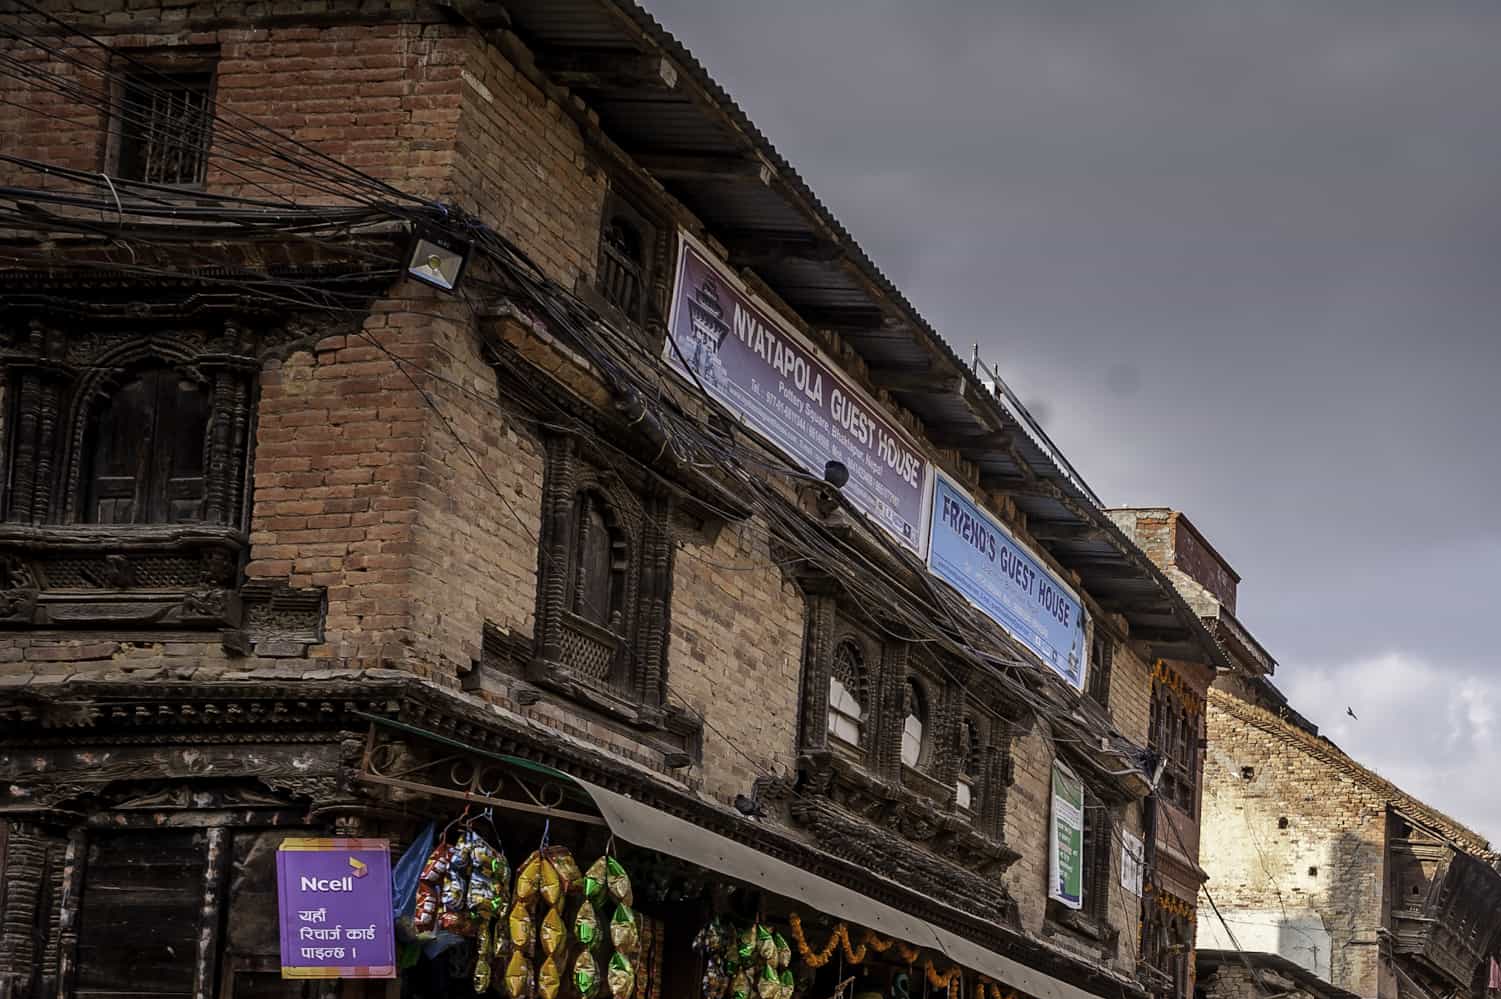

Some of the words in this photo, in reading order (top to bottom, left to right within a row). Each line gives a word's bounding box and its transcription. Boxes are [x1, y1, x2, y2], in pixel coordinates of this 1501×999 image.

[733, 302, 823, 407] NYATAPOLA
[831, 388, 876, 449] GUEST
[878, 428, 921, 489] HOUSE
[942, 495, 996, 562] FRIEND'S
[1000, 546, 1035, 596] GUEST
[1039, 580, 1070, 628] HOUSE
[300, 876, 353, 892] Ncell
[298, 908, 327, 923] यहाँ
[299, 925, 341, 940] रिचार्ज
[345, 924, 376, 940] कार्ड
[301, 947, 345, 960] पाइन्छ
